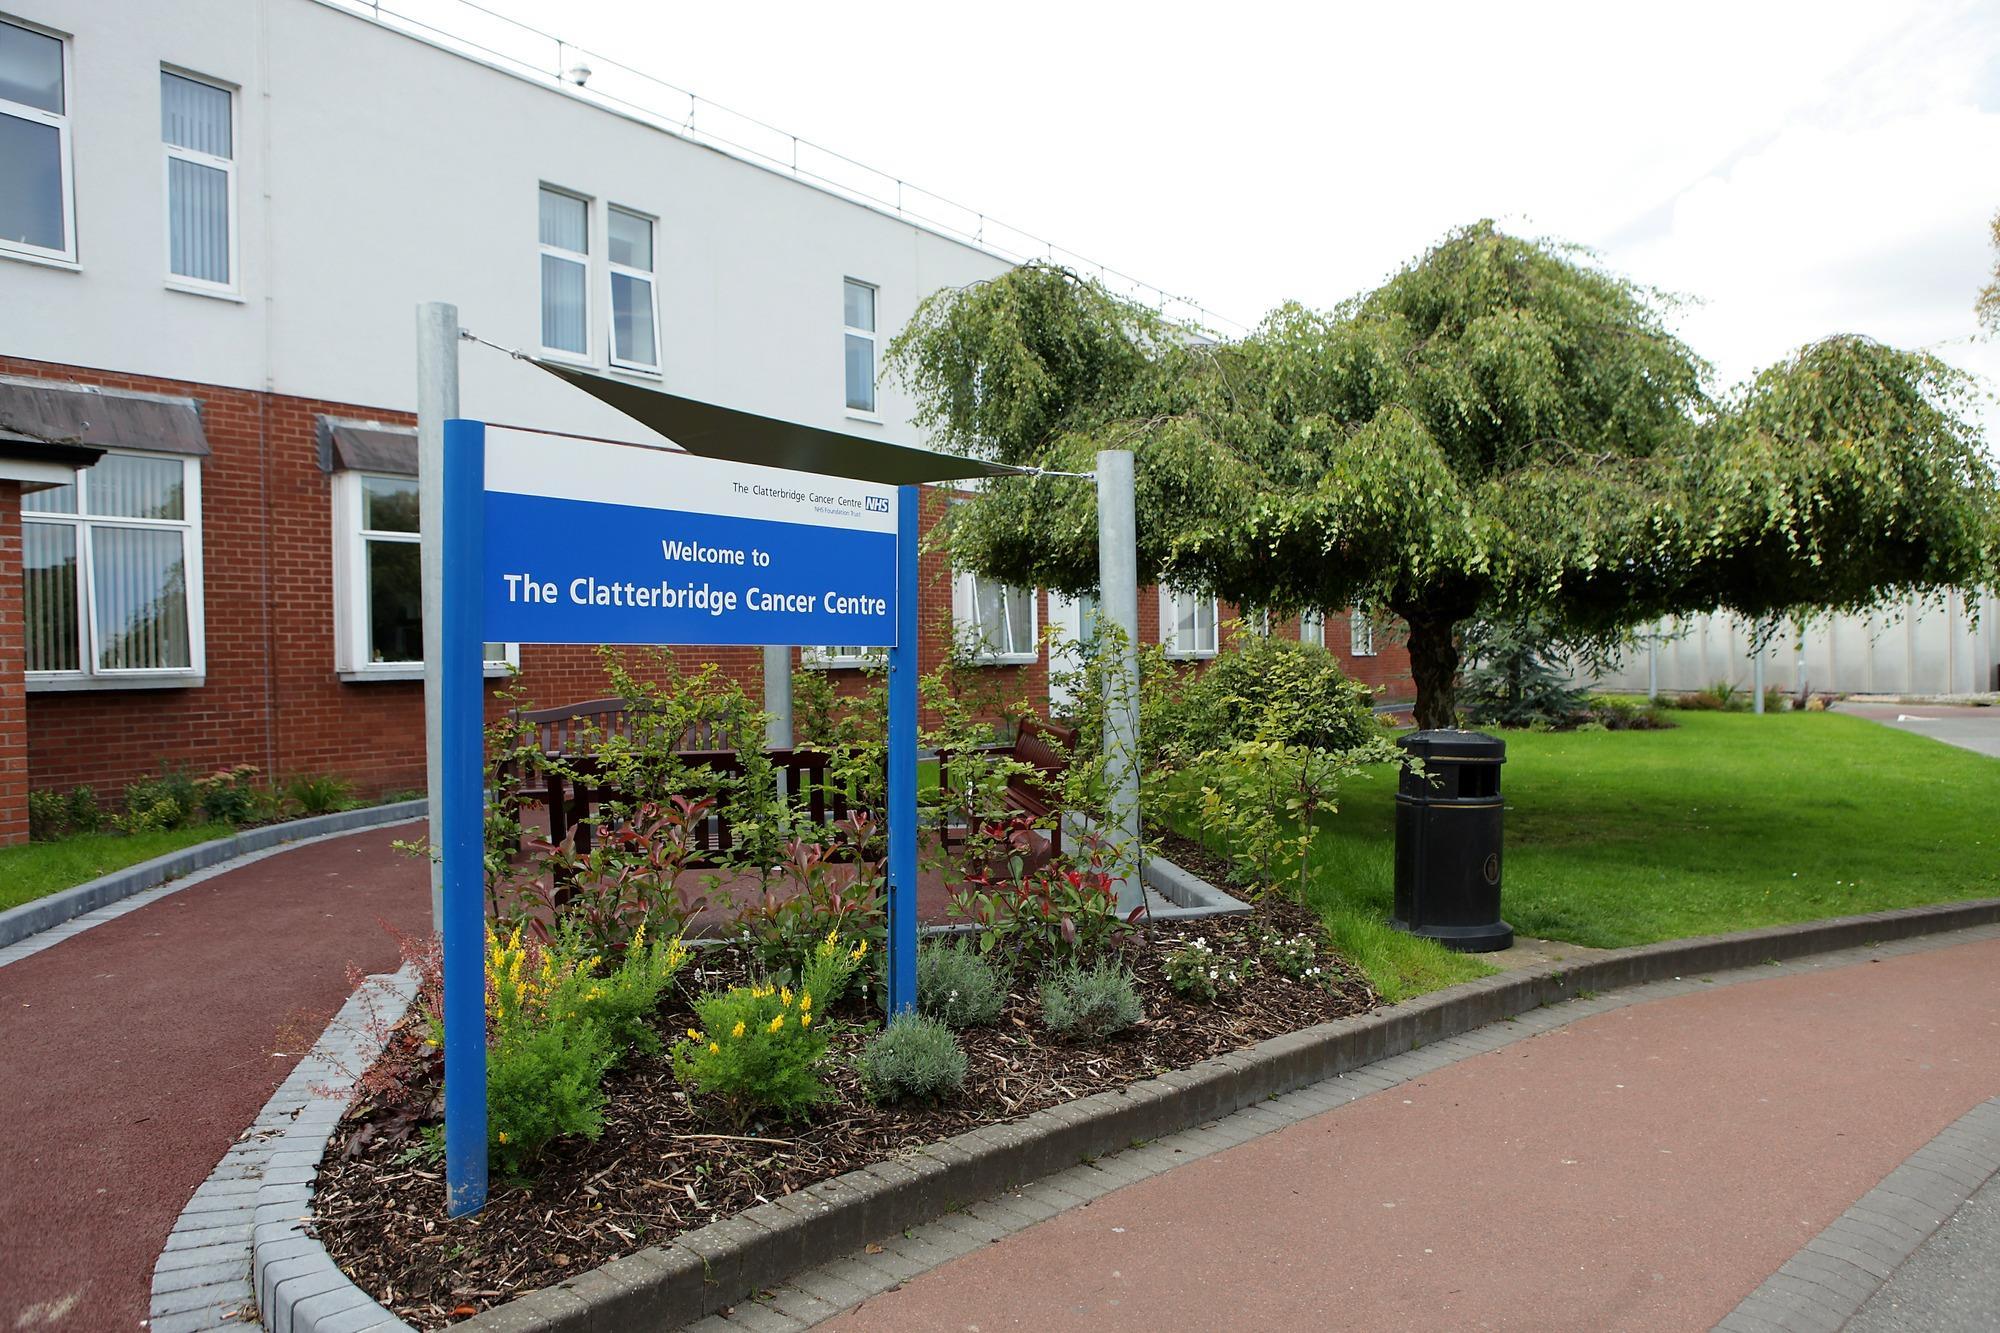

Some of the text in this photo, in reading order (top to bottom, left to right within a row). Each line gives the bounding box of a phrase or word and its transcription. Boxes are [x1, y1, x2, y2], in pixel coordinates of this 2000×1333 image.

[733, 482, 862, 508] The Clatterbridge Cancer Centre
[865, 496, 889, 513] NHS
[824, 506, 850, 516] Foundation
[662, 540, 770, 567] Welcome to
[503, 573, 886, 616] The Clatterbridge Cancer Centre
